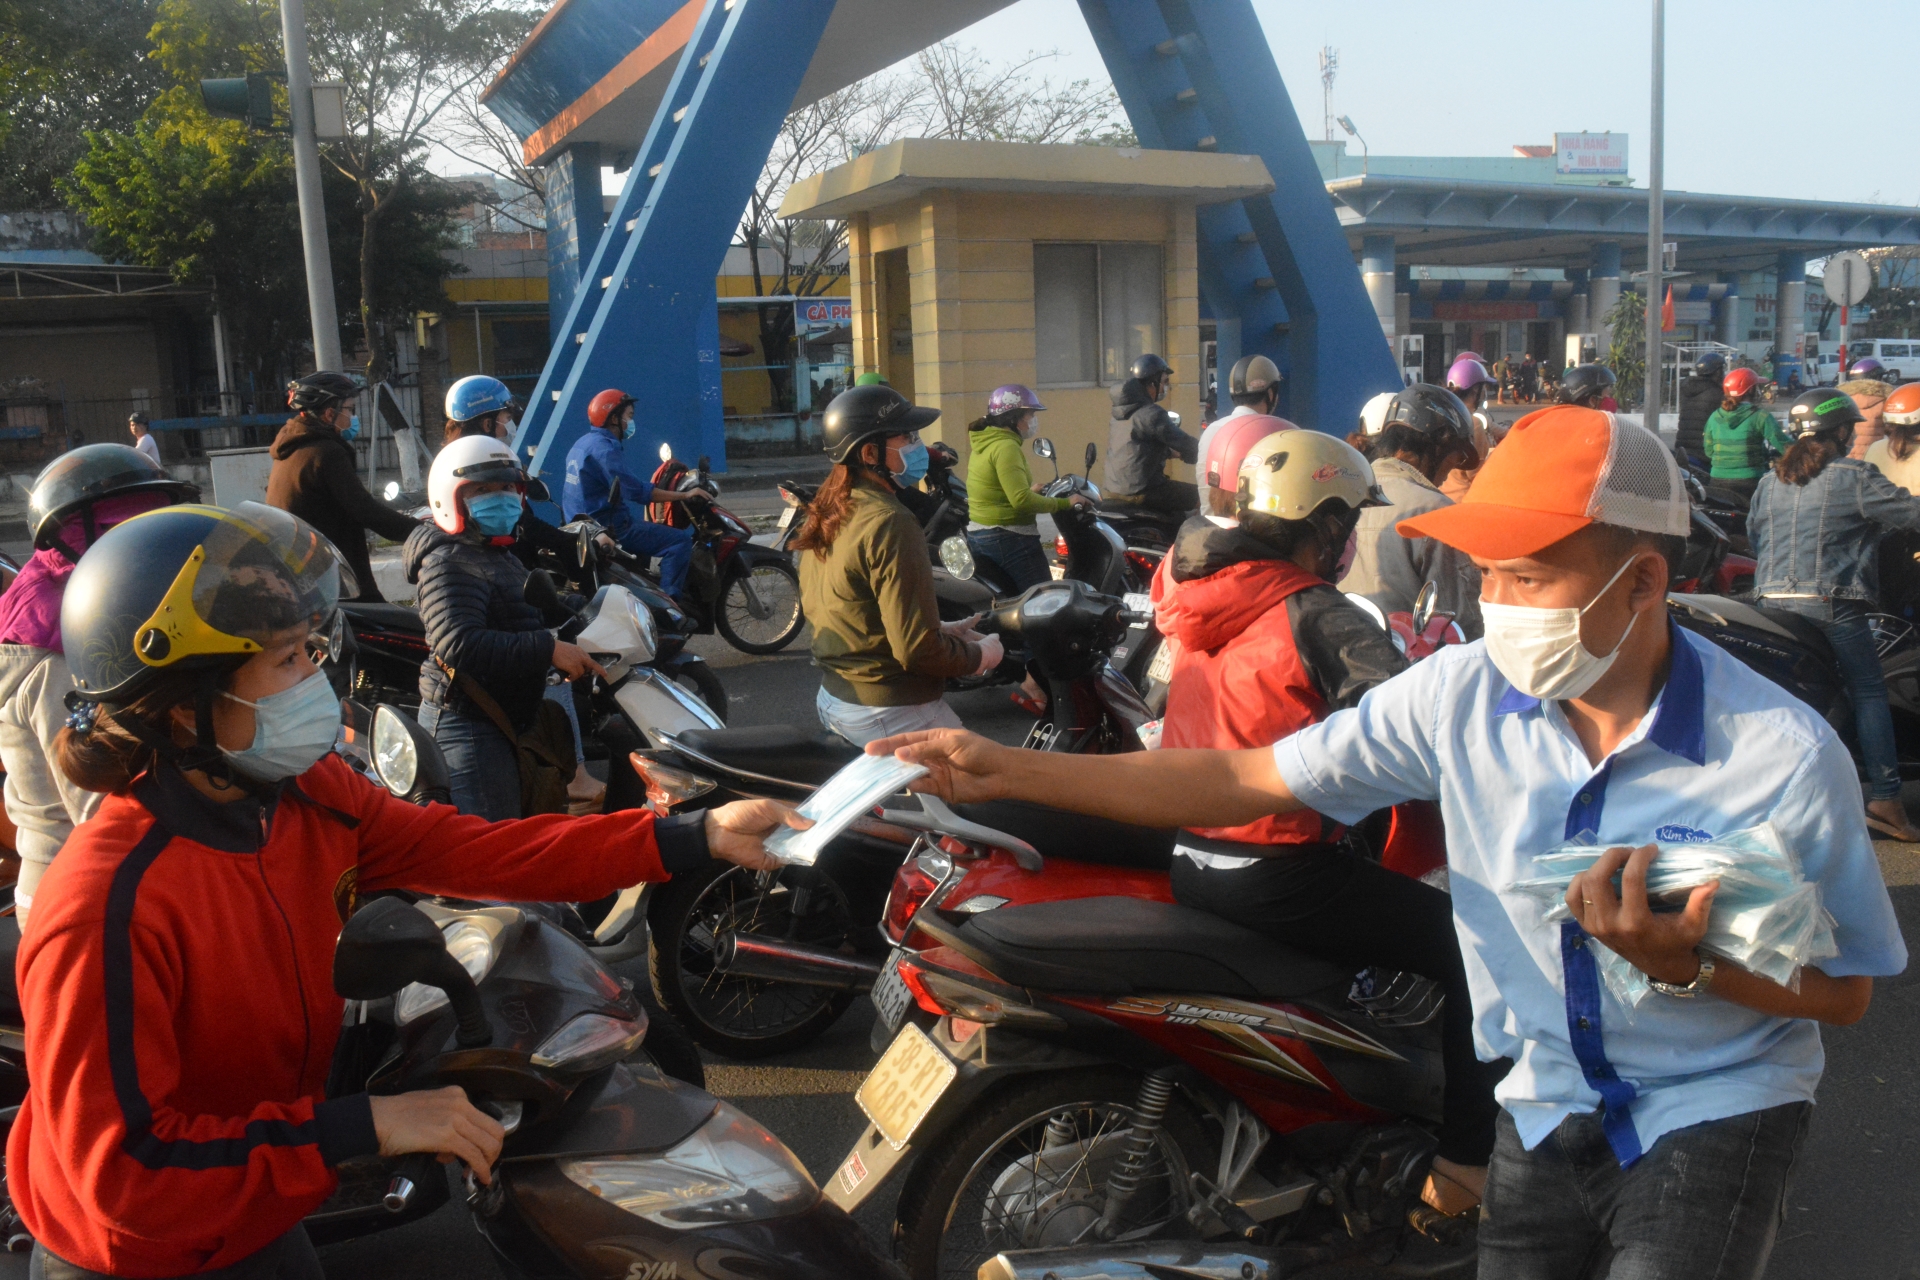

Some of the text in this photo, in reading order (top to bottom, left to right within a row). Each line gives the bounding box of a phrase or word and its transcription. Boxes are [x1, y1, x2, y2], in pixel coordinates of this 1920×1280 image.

[1561, 136, 1581, 149] NHÀ
[1566, 150, 1574, 160] &
[1577, 153, 1597, 167] NHÀ
[807, 302, 852, 321] CÀ PH
[1660, 828, 1683, 841] Kim
[1165, 1015, 1200, 1026] 110
[625, 1261, 678, 1280] SYM
